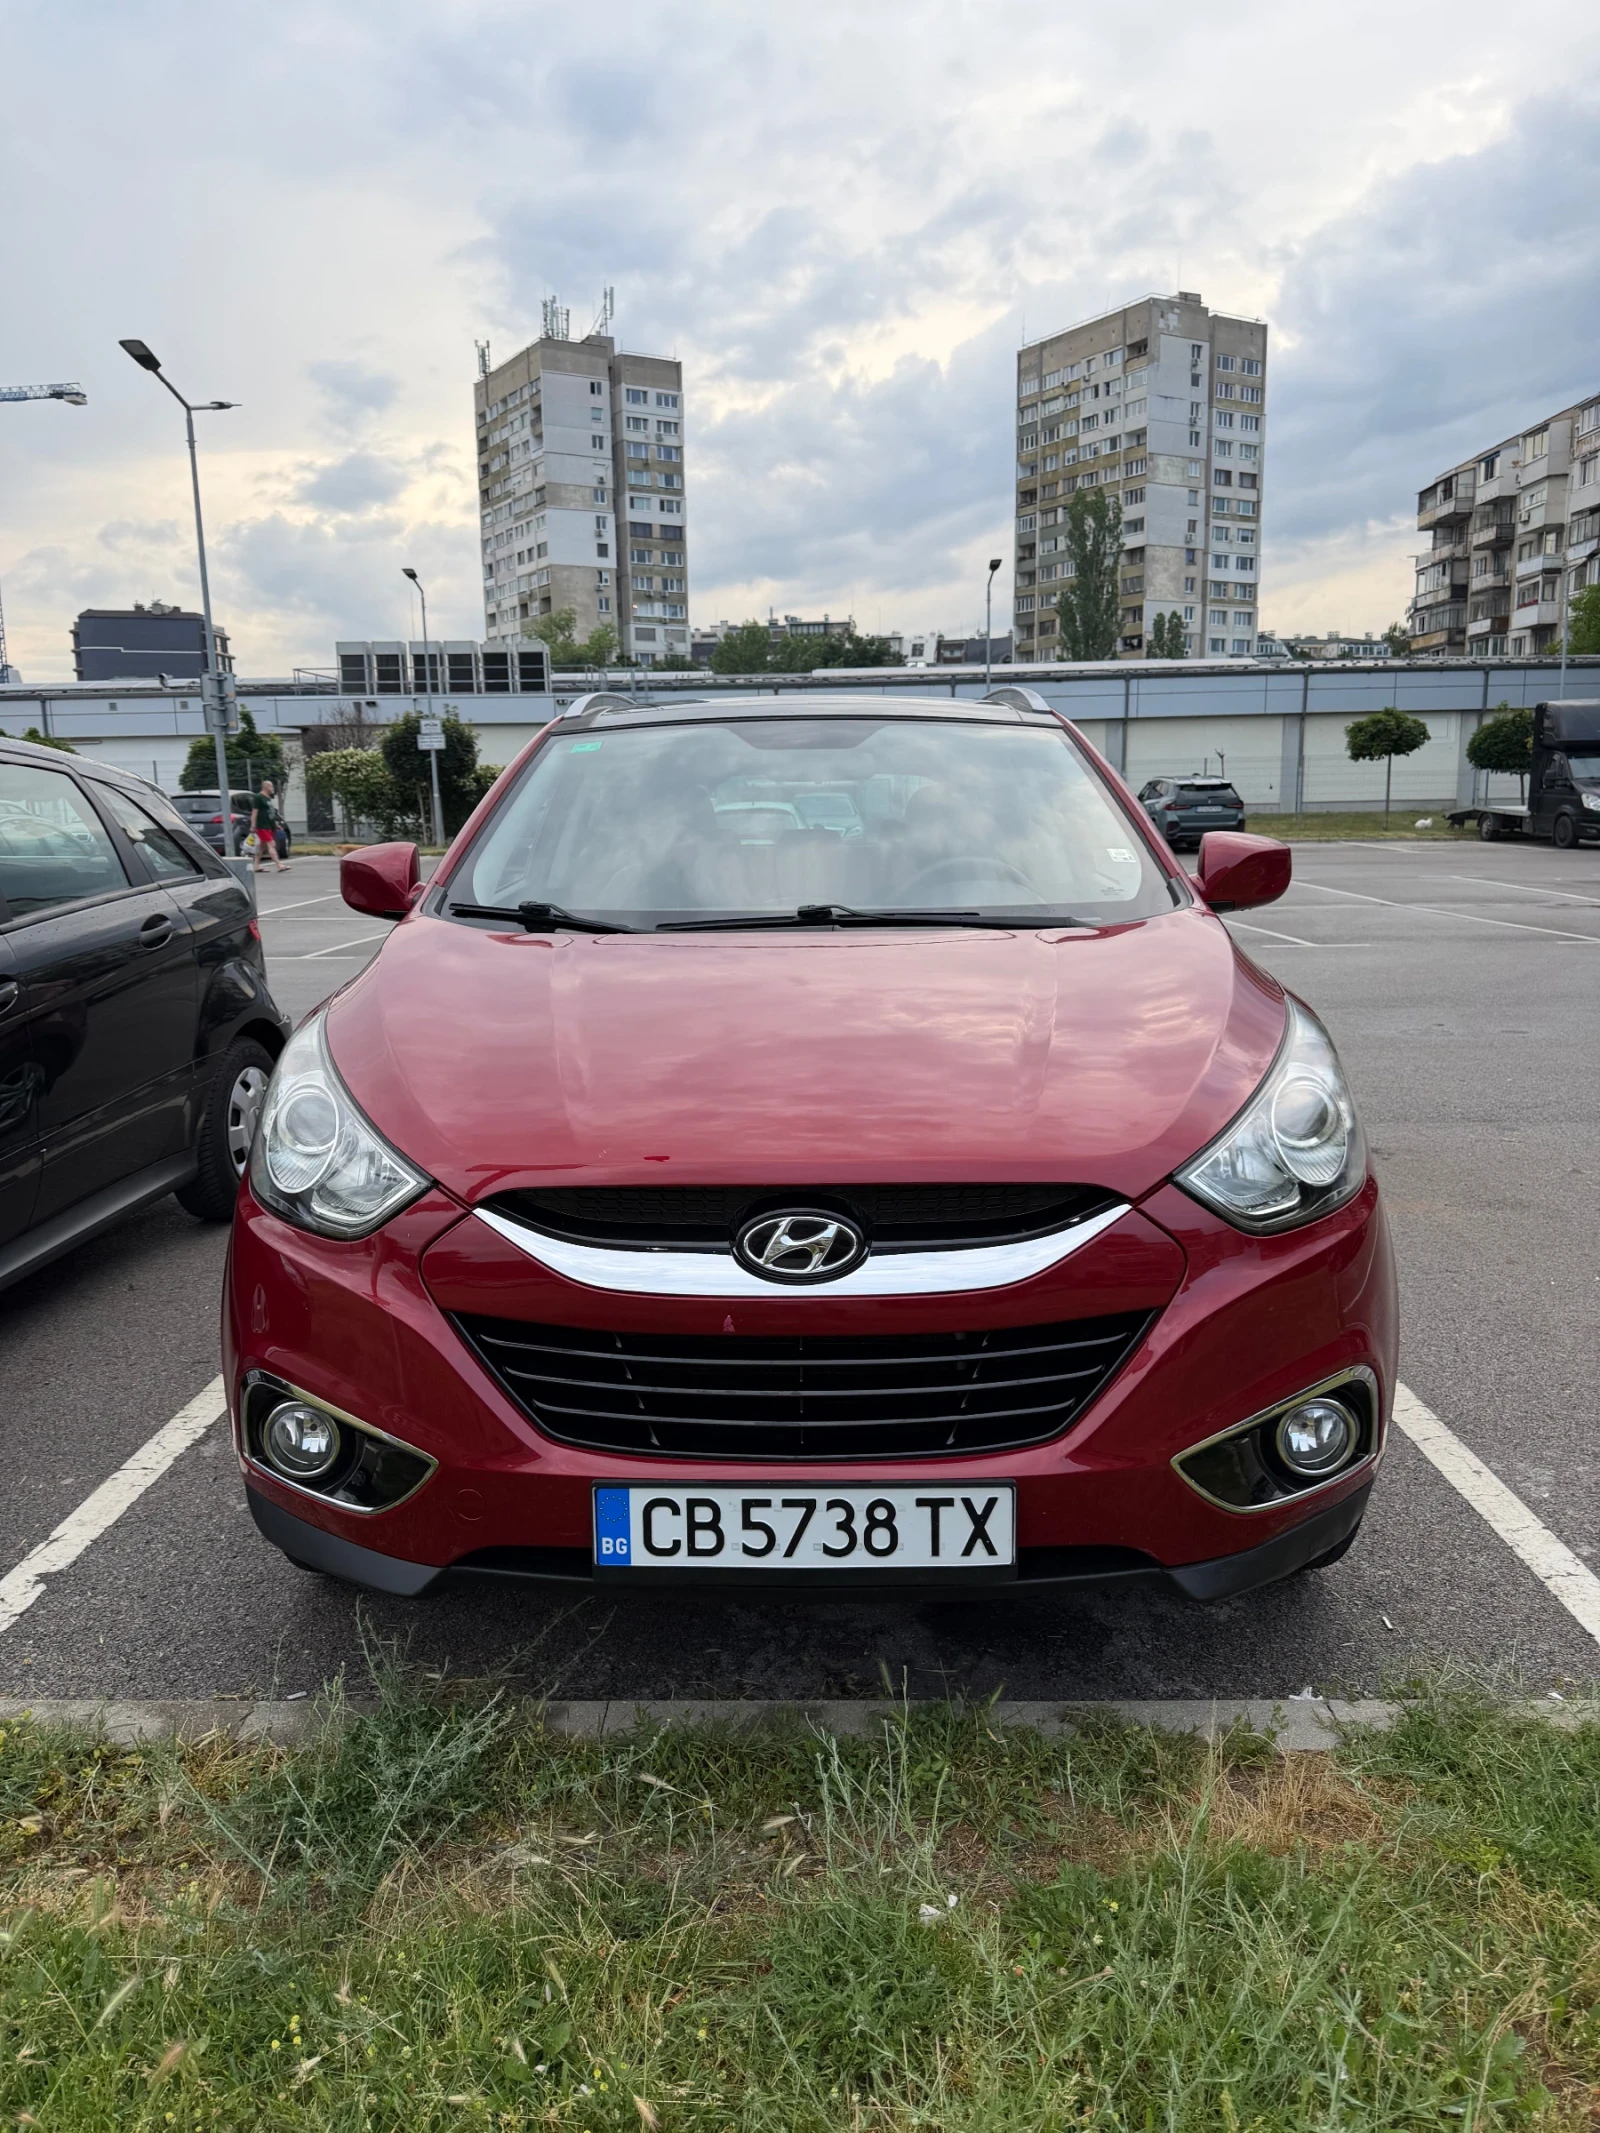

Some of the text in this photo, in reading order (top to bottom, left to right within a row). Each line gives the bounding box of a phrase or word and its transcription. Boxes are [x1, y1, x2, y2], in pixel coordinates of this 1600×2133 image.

[602, 1537, 628, 1555] BG
[642, 1496, 999, 1558] CB 5738 TX
